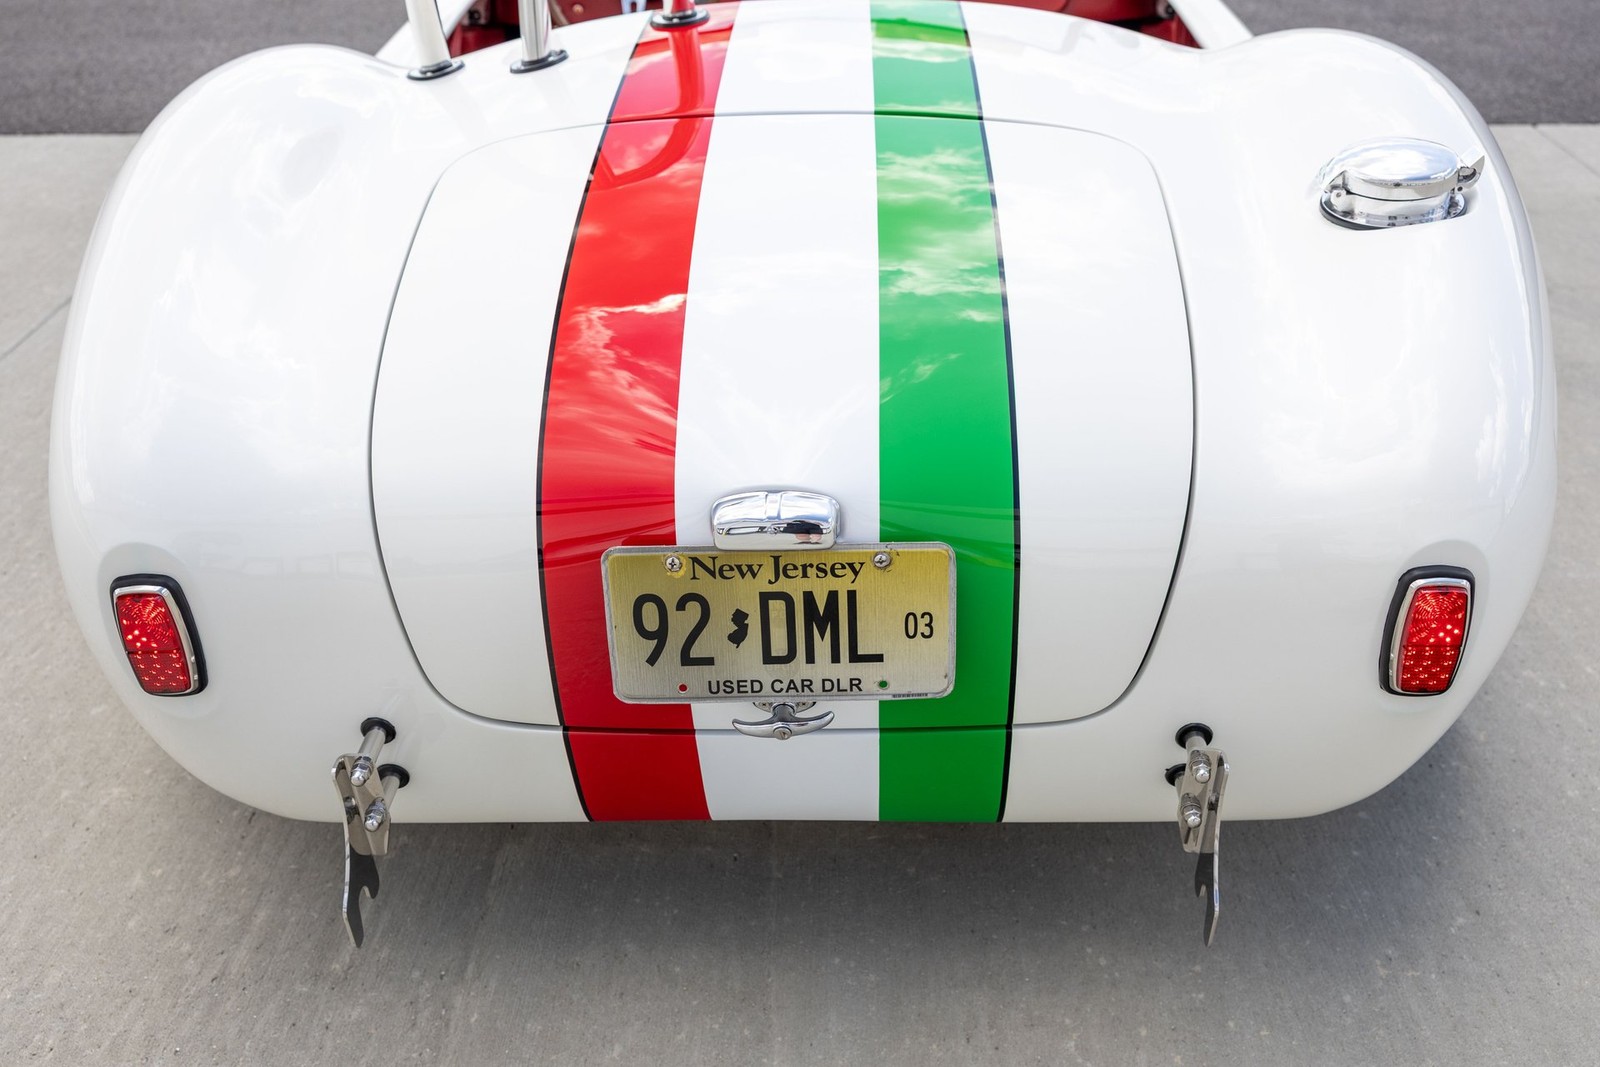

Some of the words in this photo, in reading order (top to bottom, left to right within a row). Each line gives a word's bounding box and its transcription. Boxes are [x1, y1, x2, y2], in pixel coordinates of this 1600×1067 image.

[690, 556, 763, 580] New
[768, 555, 866, 585] Jersey
[632, 592, 715, 667] 92
[758, 590, 884, 665] DML
[904, 612, 934, 639] 03
[708, 679, 763, 695] USED
[770, 678, 815, 694] CAR
[821, 678, 863, 693] DLR
